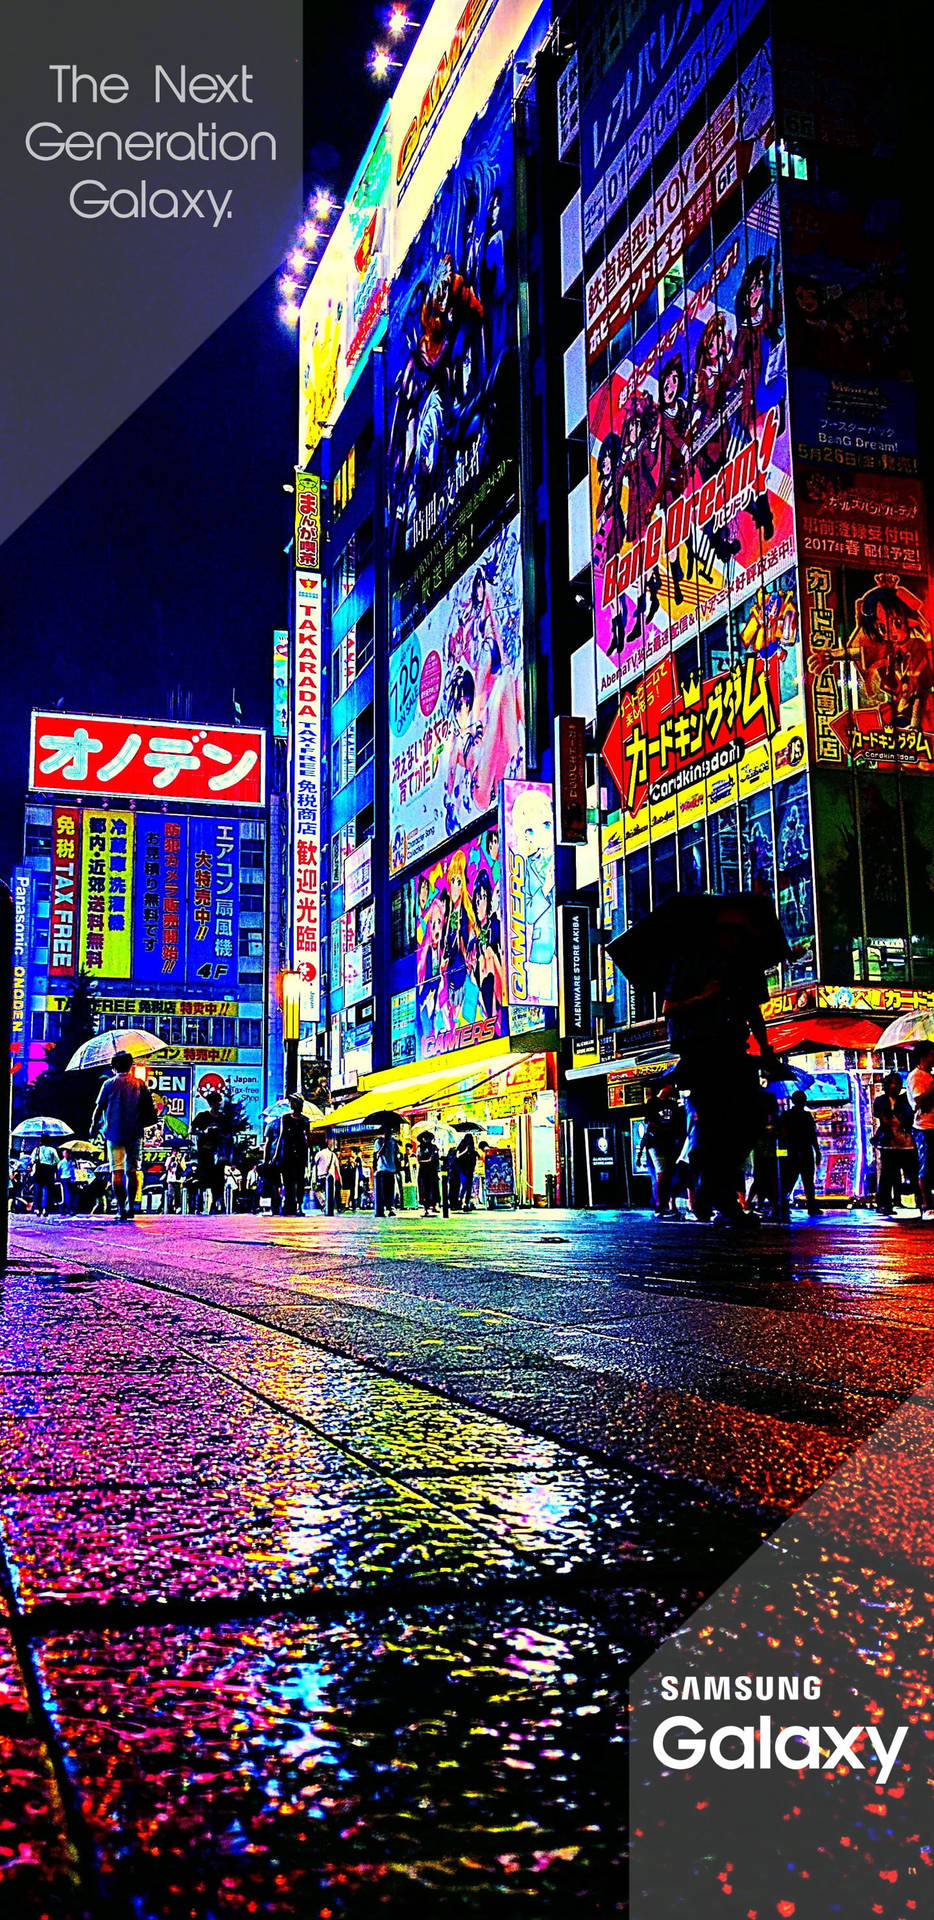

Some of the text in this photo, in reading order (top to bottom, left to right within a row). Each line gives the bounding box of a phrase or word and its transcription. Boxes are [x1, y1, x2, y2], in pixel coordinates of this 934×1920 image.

[717, 163, 736, 195] 6F
[855, 437, 899, 454] Dream!
[298, 492, 318, 566] まんが喫茶
[602, 406, 778, 610] BanG Dream!
[298, 604, 318, 718] TAKARADA
[39, 727, 258, 791] オノデン
[625, 656, 777, 809] カードキングダム
[851, 729, 934, 761] カードキングダム
[56, 816, 75, 859] 免税
[297, 779, 318, 836] 免税商店
[14, 877, 30, 956] Panasonic
[53, 863, 74, 967] TAX FREE
[297, 839, 318, 952] 歓迎光臨
[509, 853, 527, 1000] GAMERS
[12, 966, 26, 1032] ONODEN
[197, 962, 228, 980] 4F
[571, 915, 582, 1028] ALIENWARE STORE AKIBA
[422, 1016, 497, 1056] GAMERS
